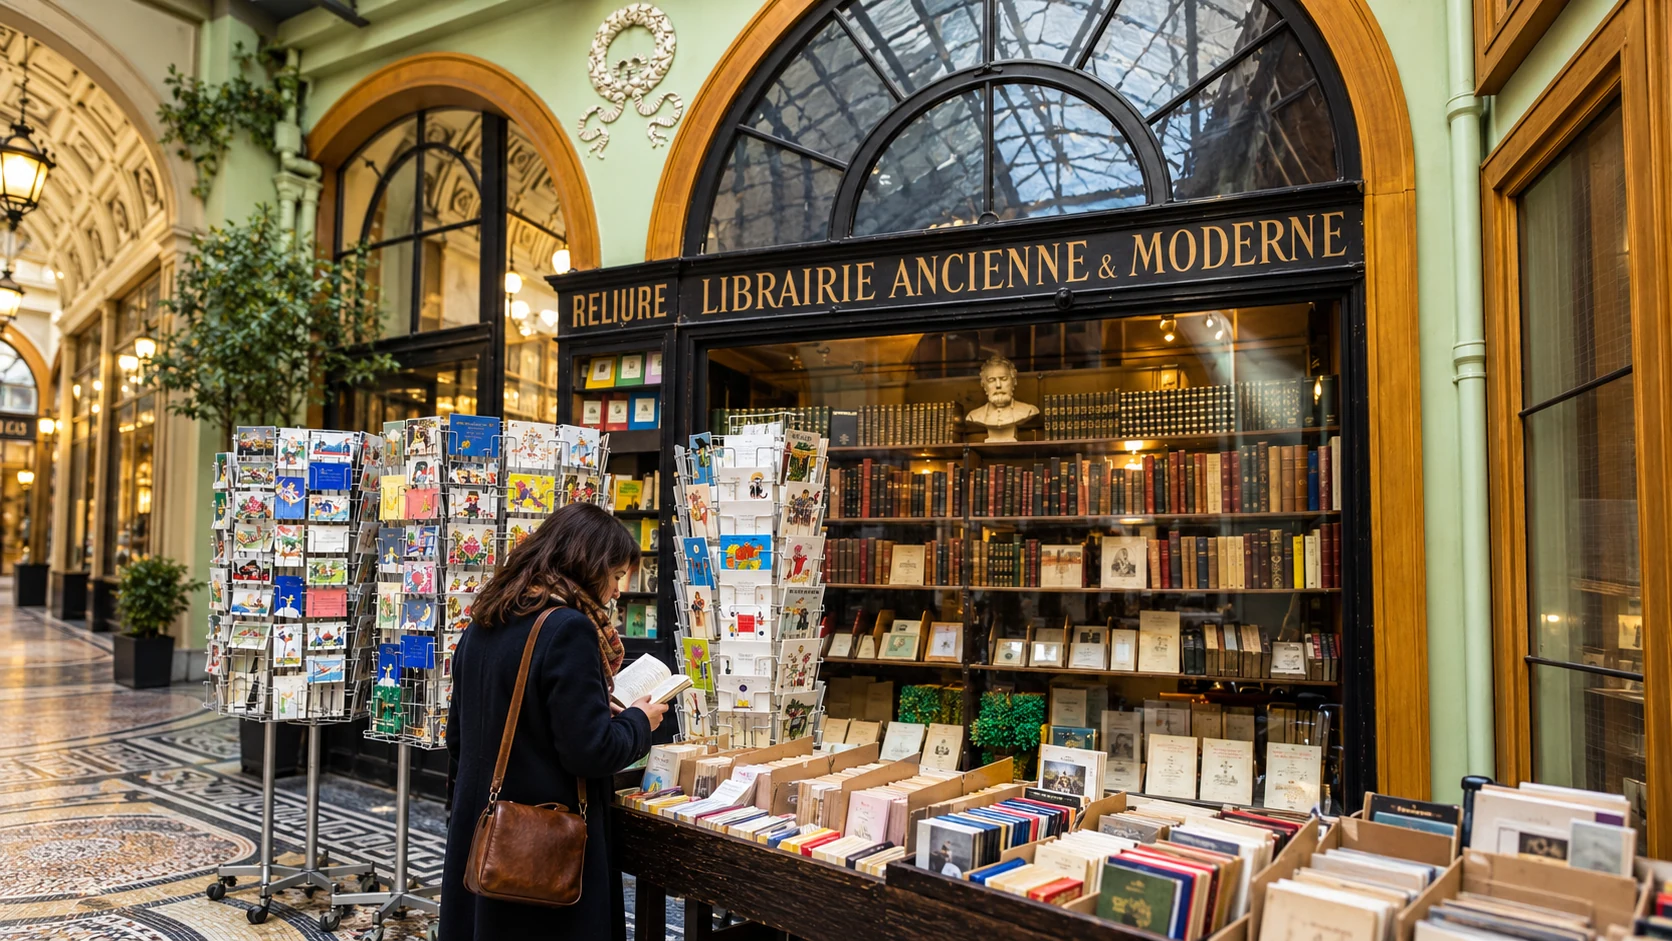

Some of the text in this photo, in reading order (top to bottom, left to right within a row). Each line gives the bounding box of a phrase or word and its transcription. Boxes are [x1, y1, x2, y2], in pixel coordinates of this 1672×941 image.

[701, 211, 1348, 315] LIBRAIRIE ANCIENNE & MODERNE
[572, 283, 667, 328] RELIURE
